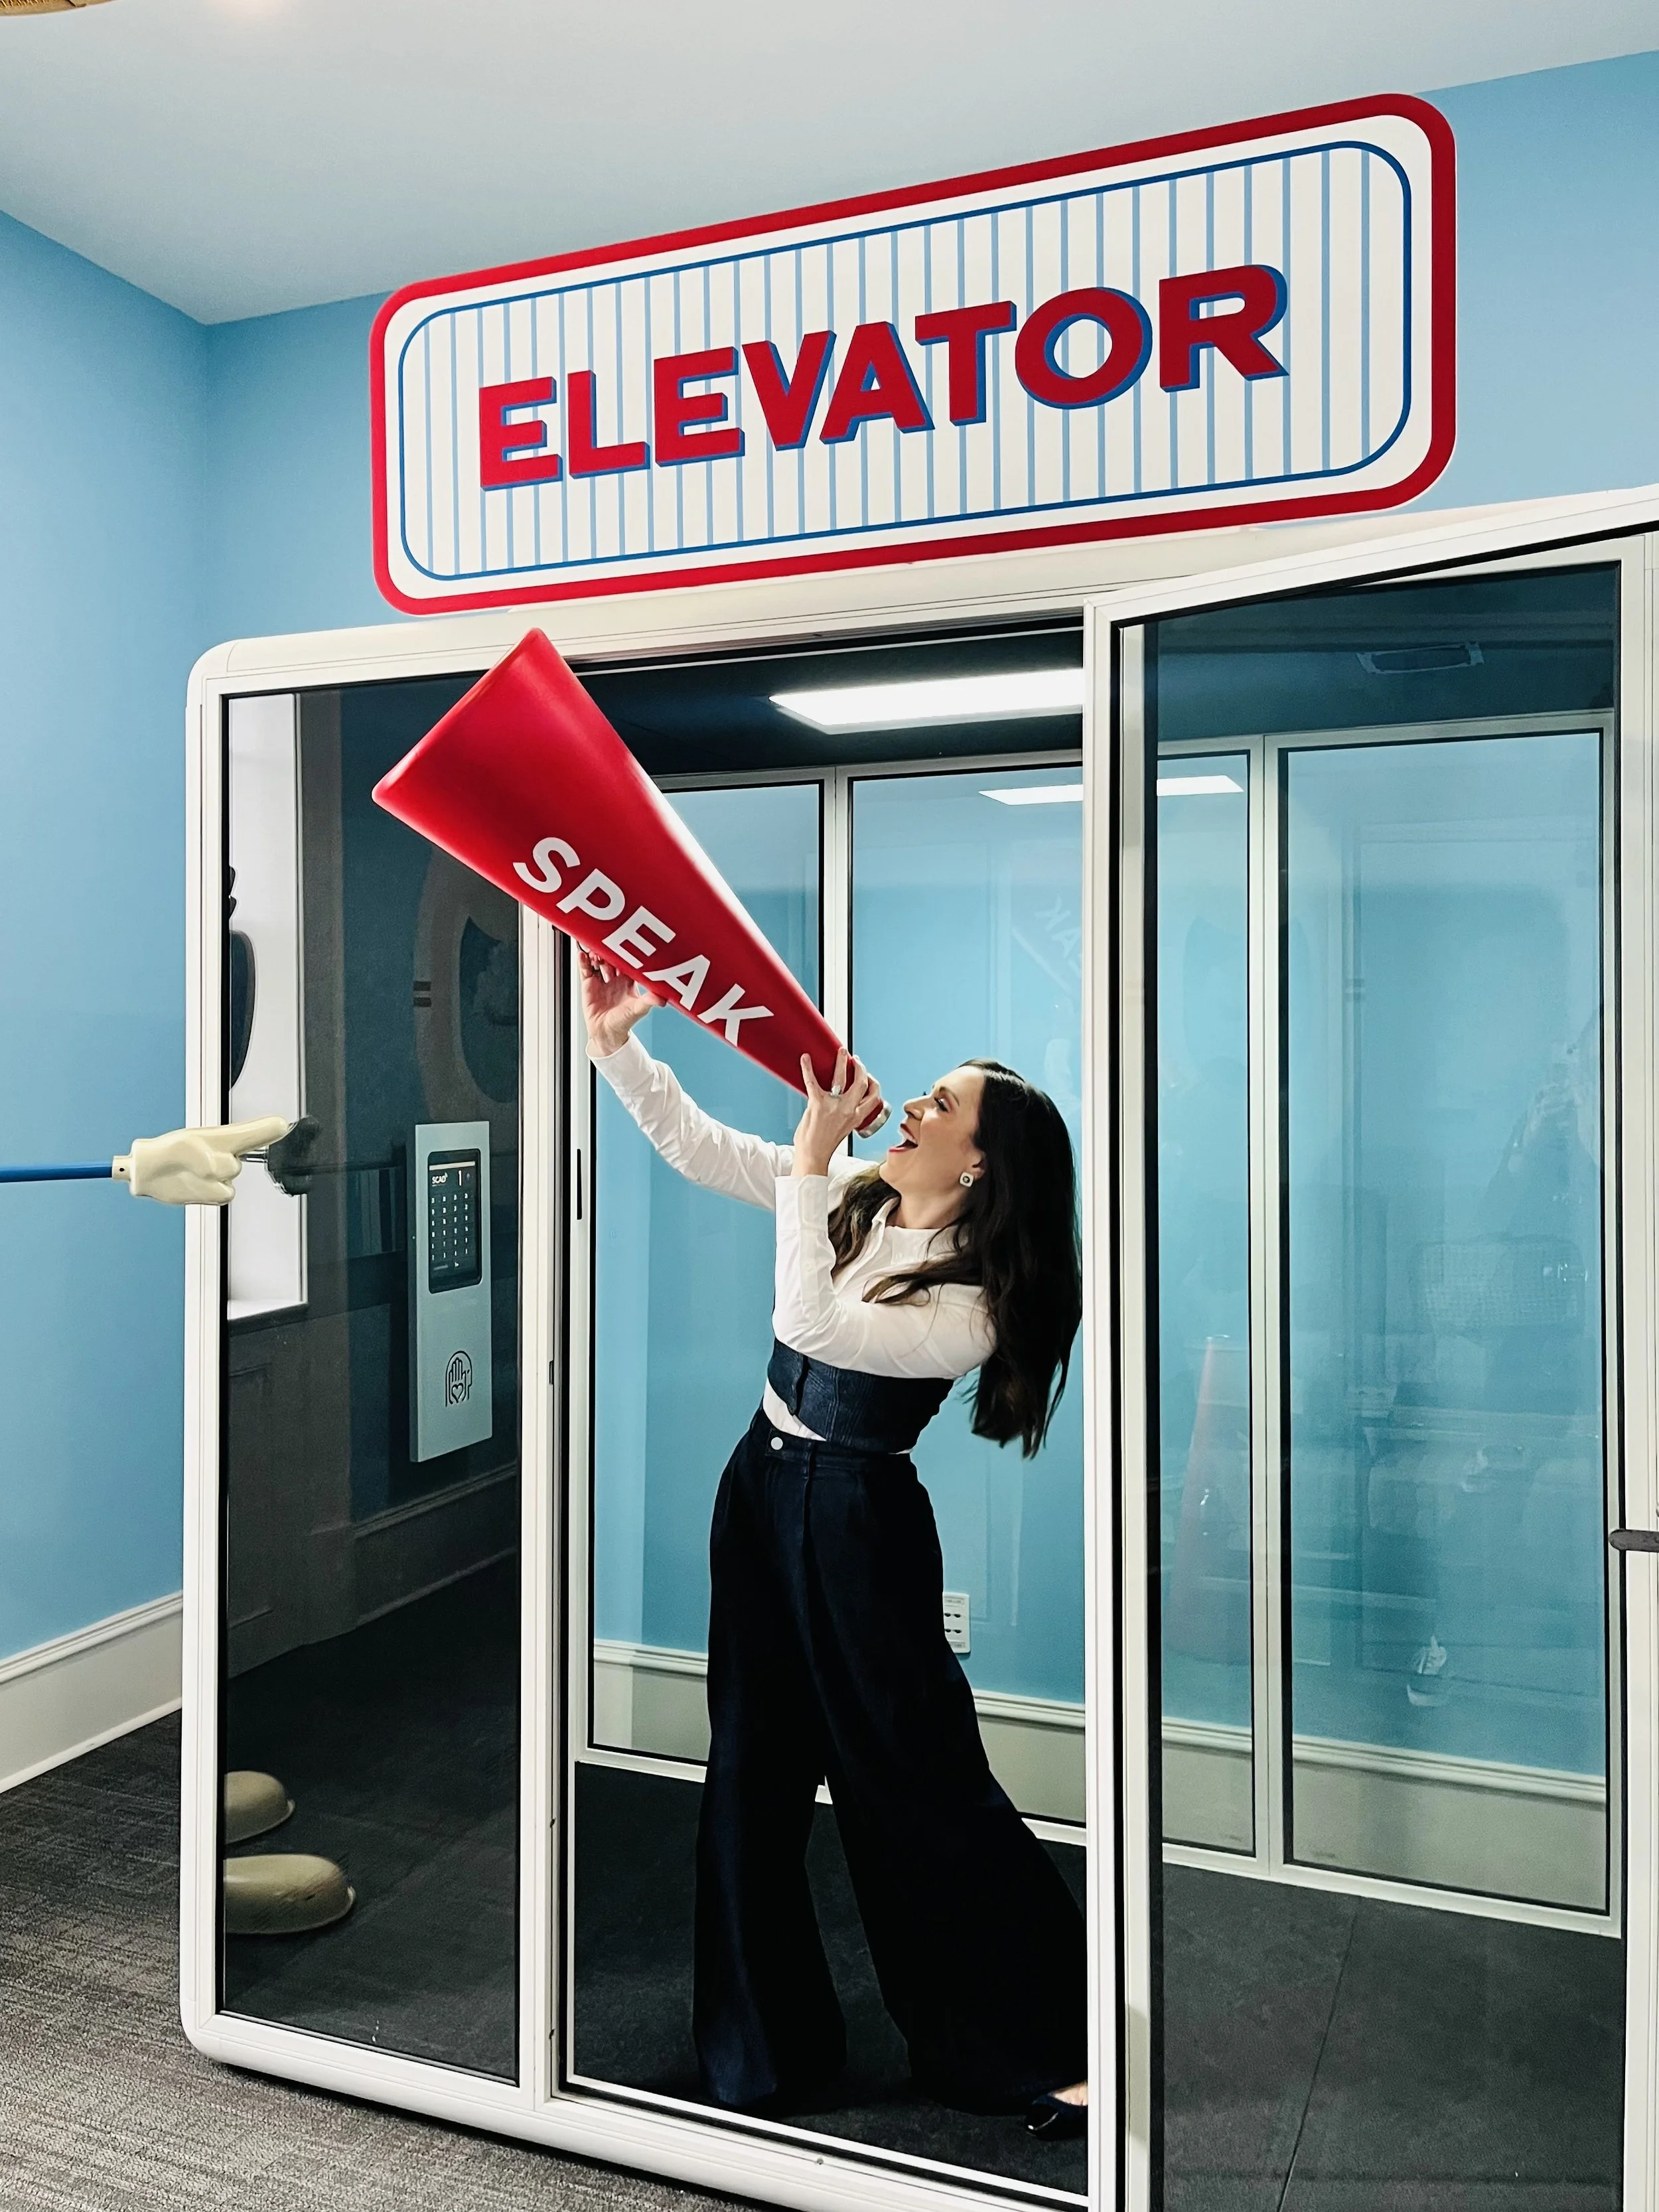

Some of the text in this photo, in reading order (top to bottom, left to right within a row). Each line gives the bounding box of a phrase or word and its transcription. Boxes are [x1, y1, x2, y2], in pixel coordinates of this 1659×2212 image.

[478, 263, 1289, 490] ELEVATOR
[513, 837, 774, 1047] SPEAK
[431, 1175, 447, 1184] SCAD
